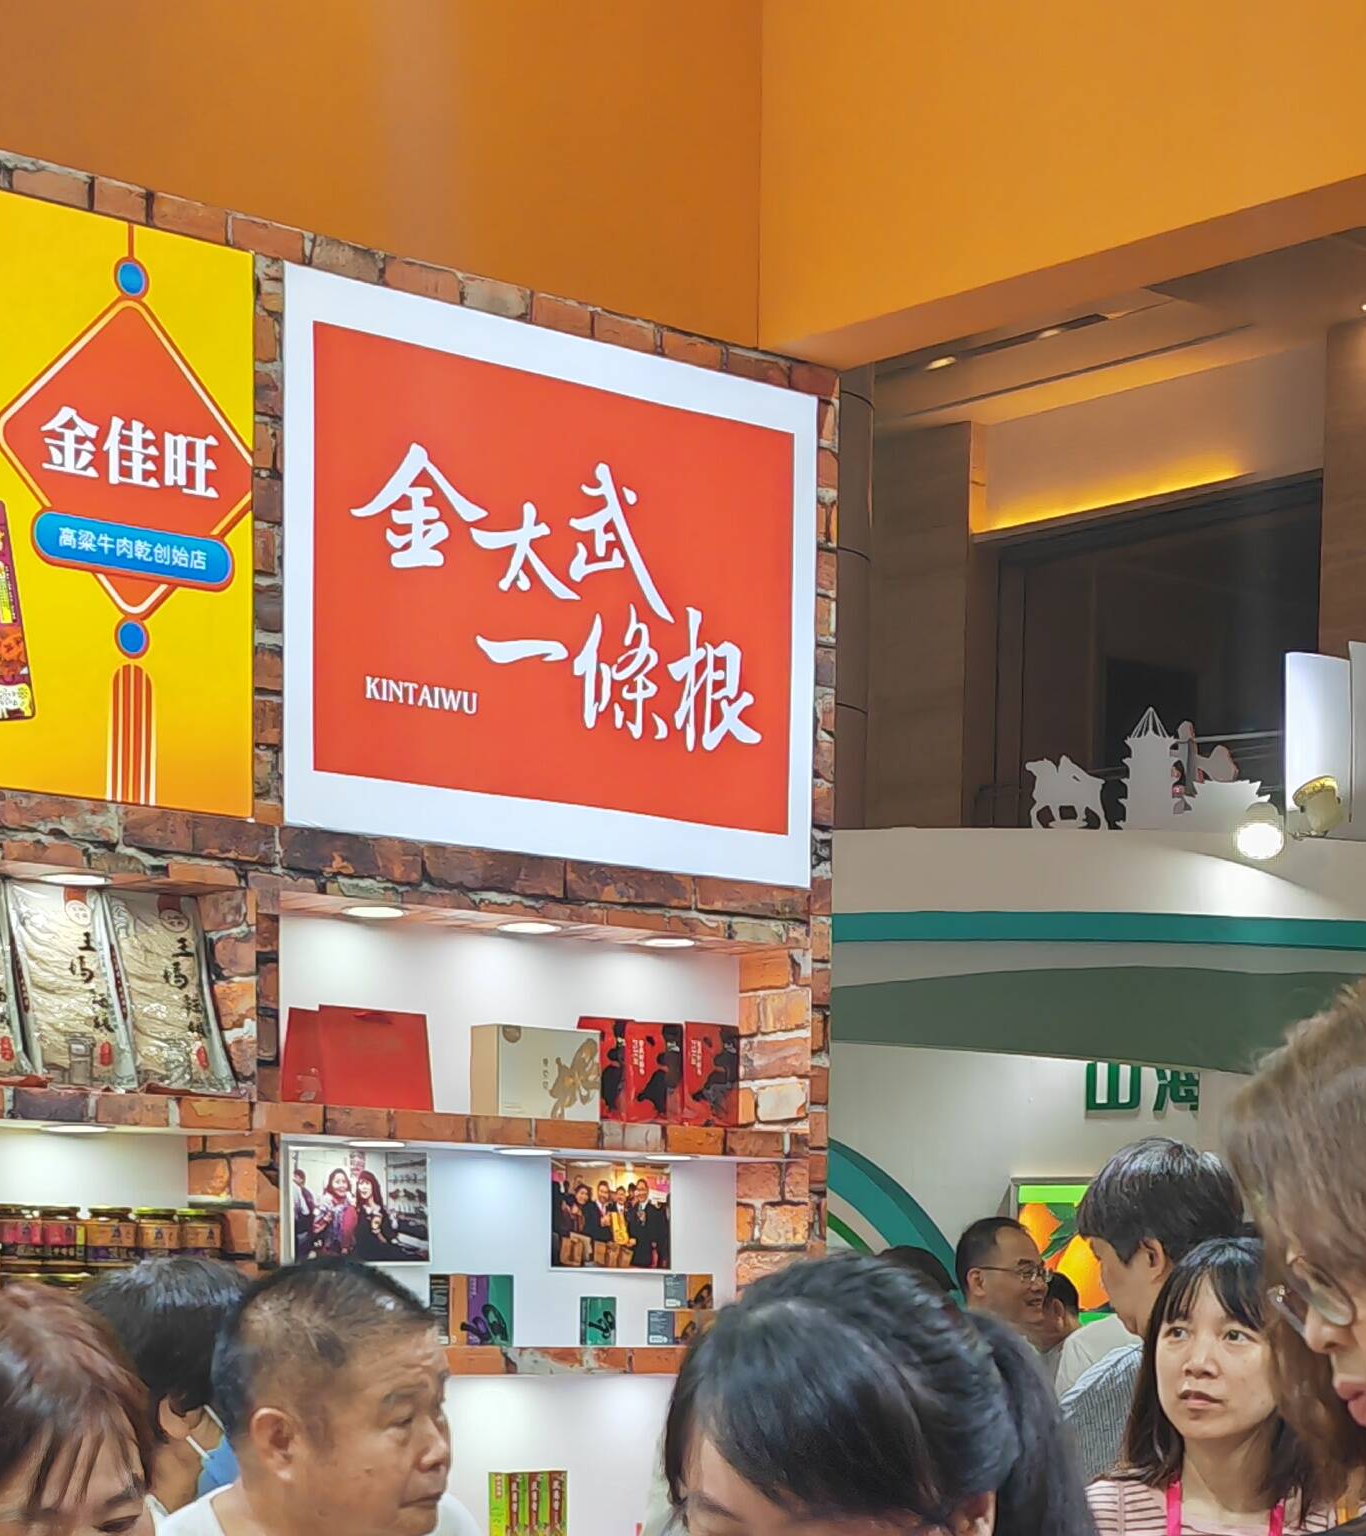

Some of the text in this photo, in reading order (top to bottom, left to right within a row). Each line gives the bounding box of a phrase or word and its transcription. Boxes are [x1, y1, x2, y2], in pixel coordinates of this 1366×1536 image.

[40, 405, 221, 500] 金佳旺
[350, 442, 674, 623] 金太武
[365, 675, 479, 716] KINTAIWU
[476, 604, 762, 752] 一條根
